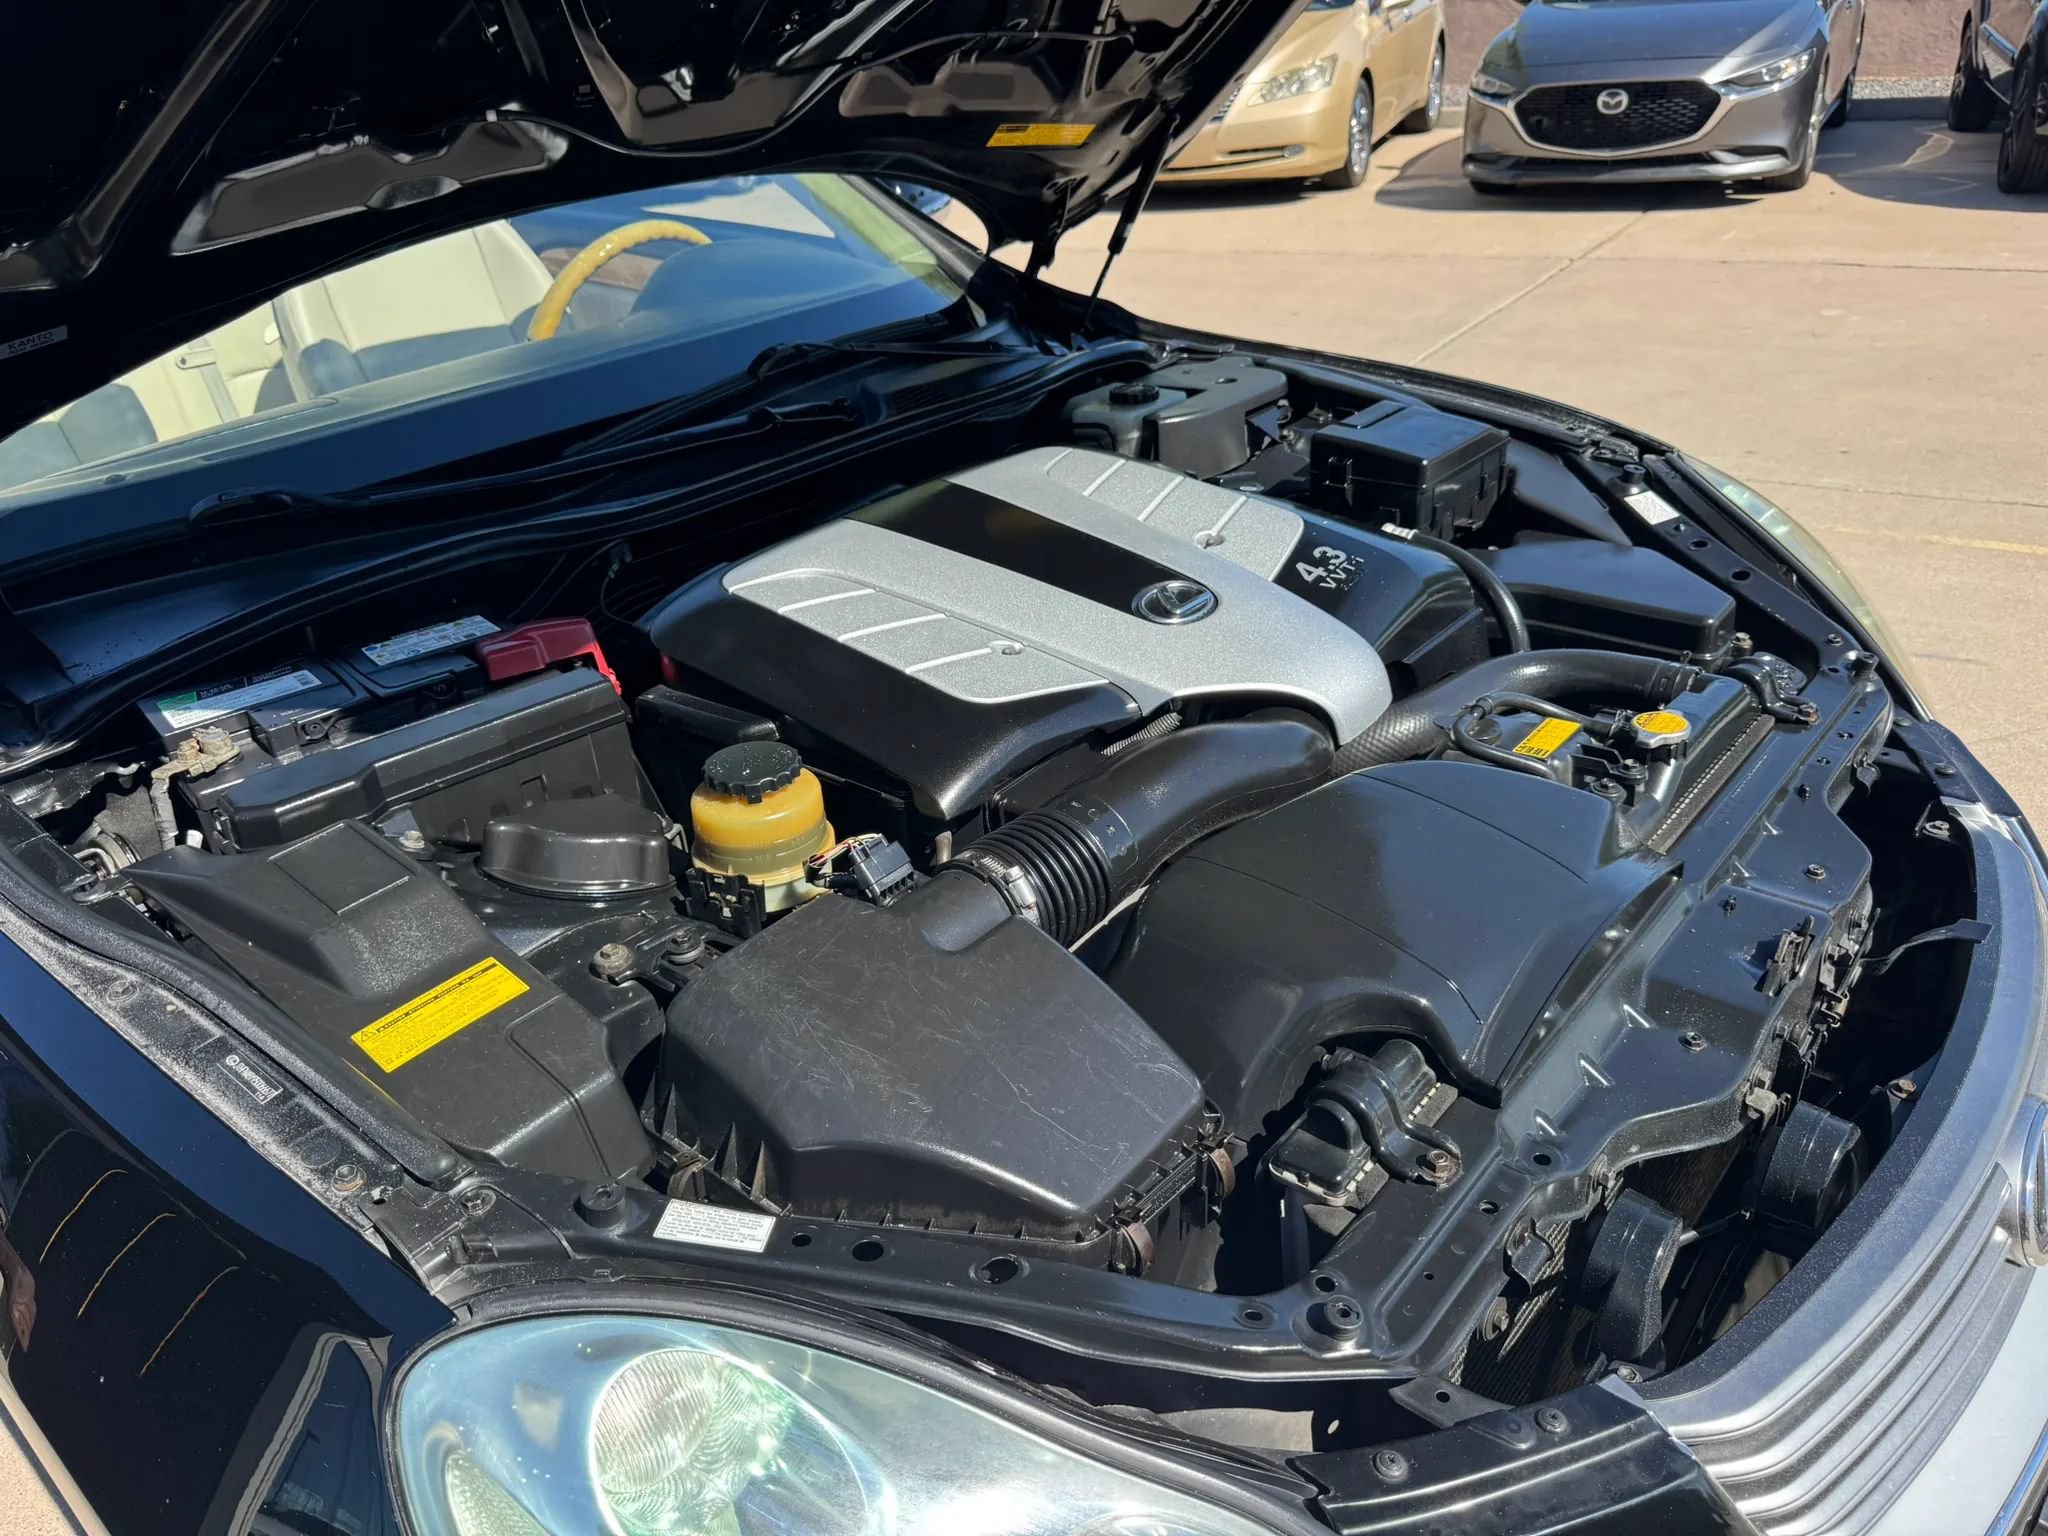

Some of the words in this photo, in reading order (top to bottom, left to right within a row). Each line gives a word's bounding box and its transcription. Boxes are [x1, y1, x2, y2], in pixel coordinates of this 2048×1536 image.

[8, 332, 53, 351] KANTO
[1295, 546, 1347, 583] 4.3
[1319, 555, 1365, 588] VVT-i
